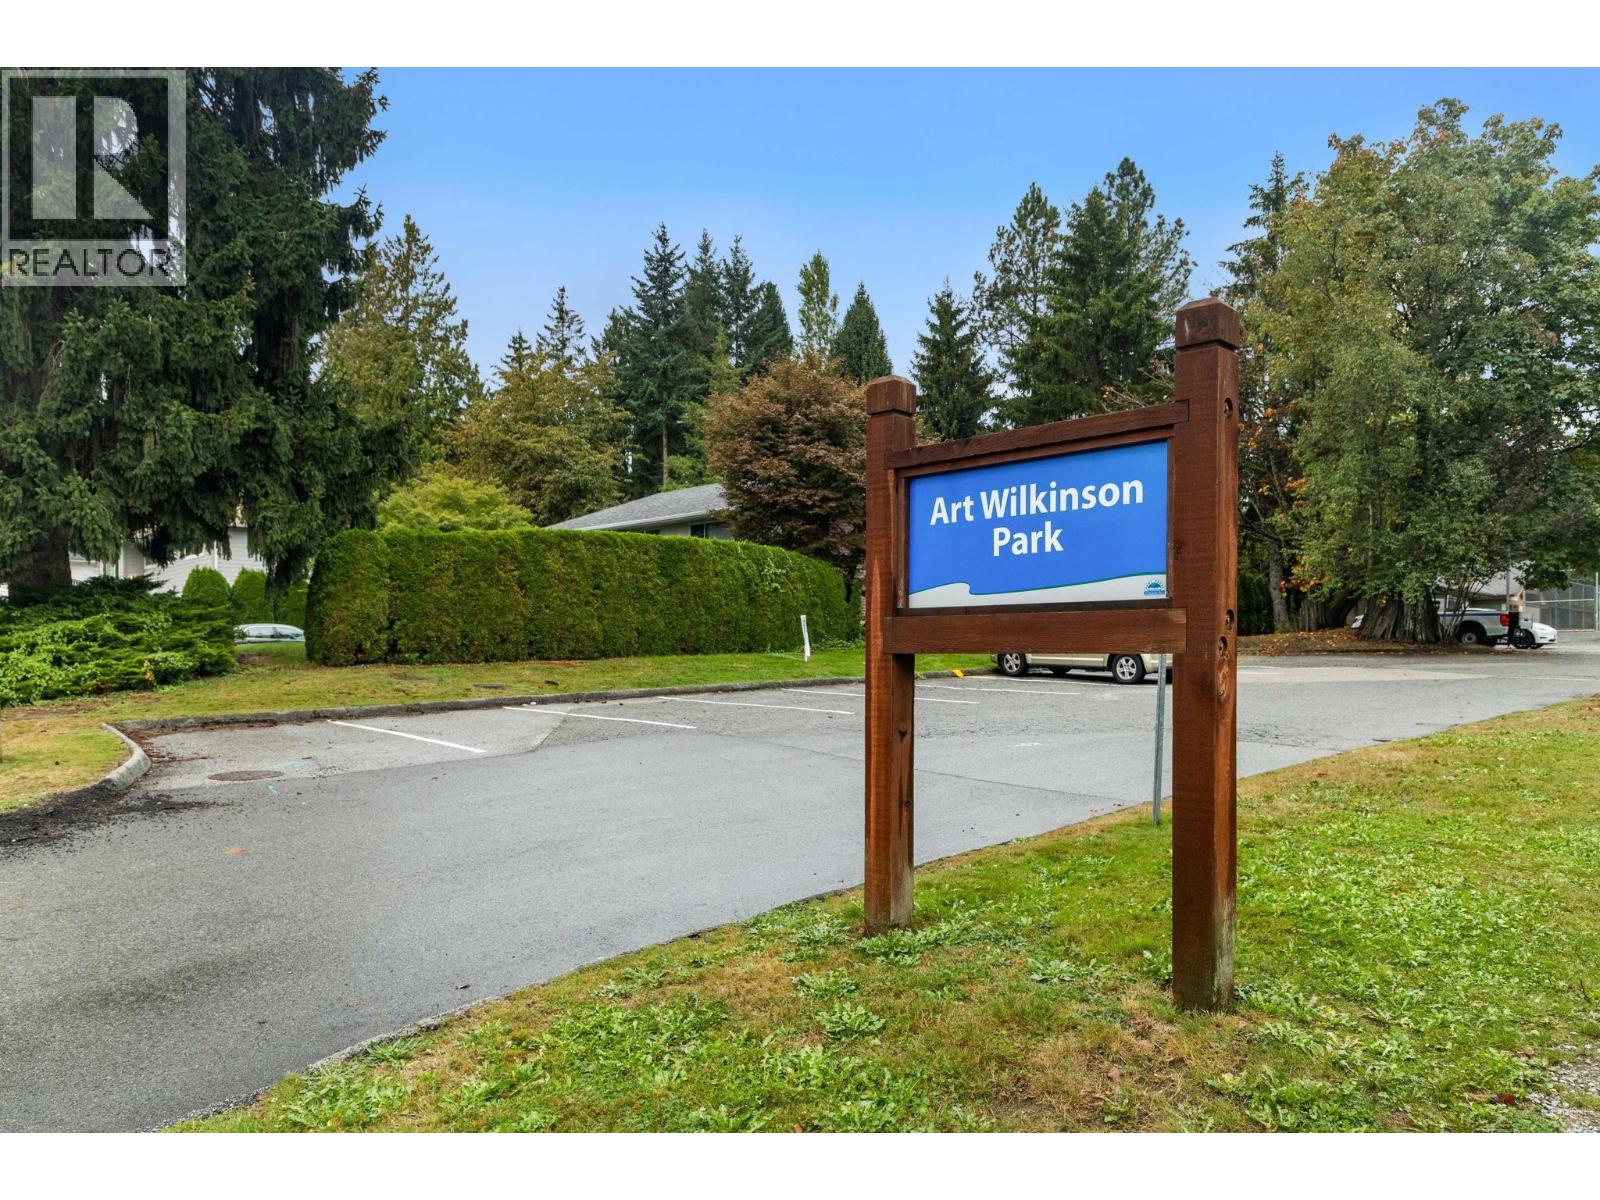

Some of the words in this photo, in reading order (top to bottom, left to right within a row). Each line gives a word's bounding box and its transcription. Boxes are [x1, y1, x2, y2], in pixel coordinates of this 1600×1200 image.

[930, 494, 975, 526] Art
[980, 478, 1144, 520] Wilkinson
[993, 520, 1064, 557] Park
